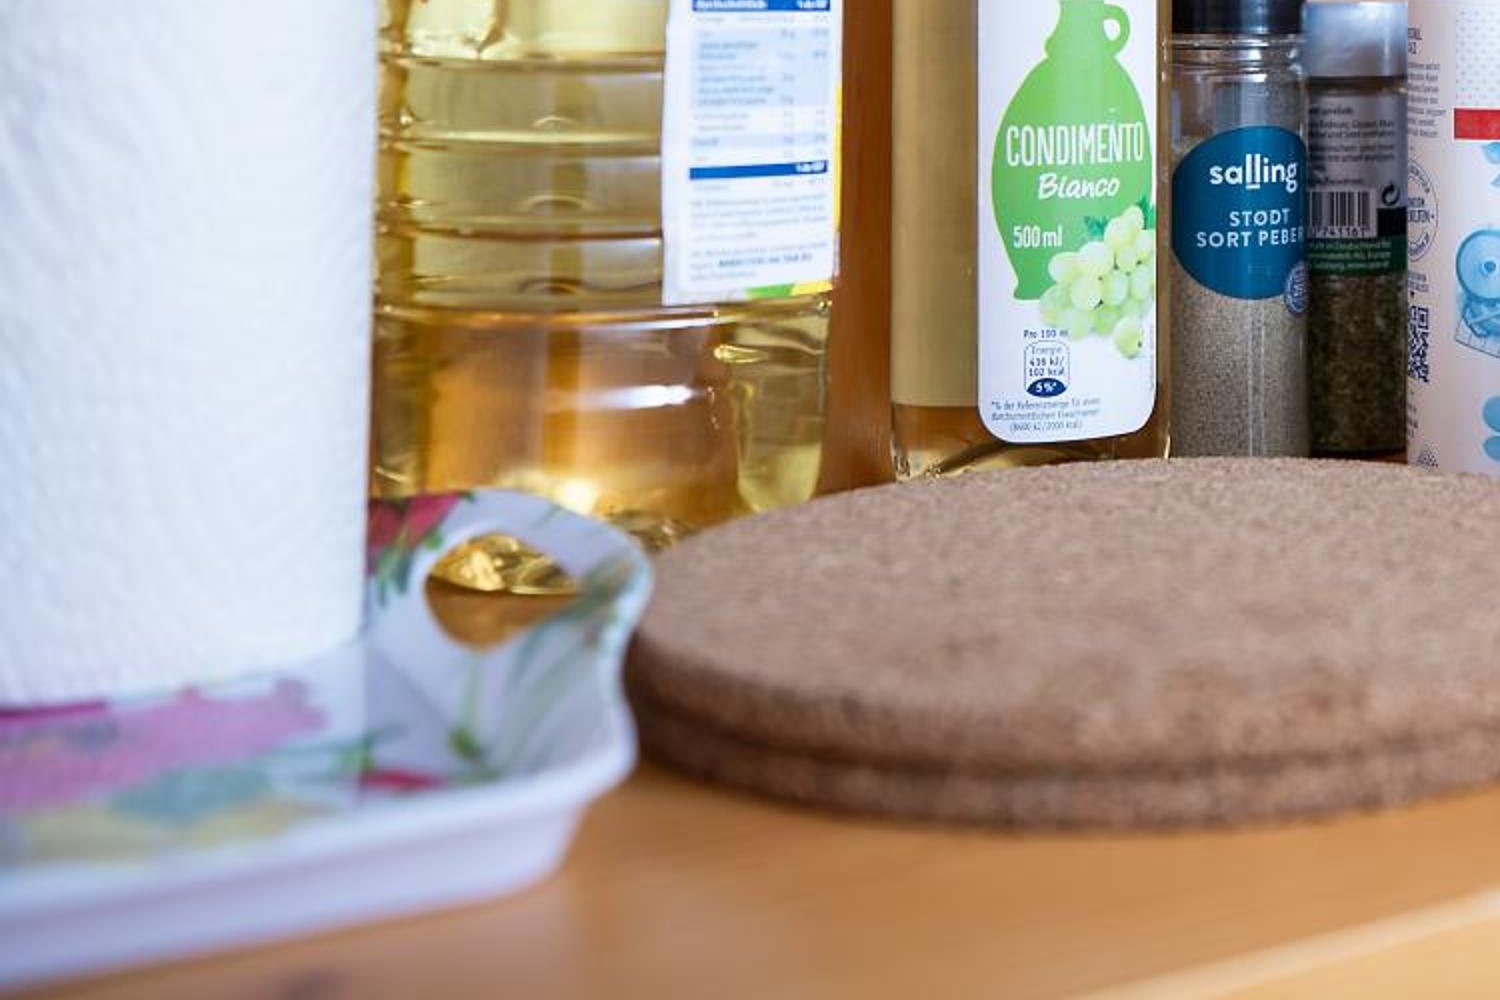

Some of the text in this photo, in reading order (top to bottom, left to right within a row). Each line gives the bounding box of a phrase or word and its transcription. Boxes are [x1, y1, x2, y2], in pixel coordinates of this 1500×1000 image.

[1006, 121, 1144, 167] CONDIMENTO
[1037, 172, 1121, 200] Bianco
[1209, 153, 1298, 194] salling
[1196, 230, 1252, 247] SORT
